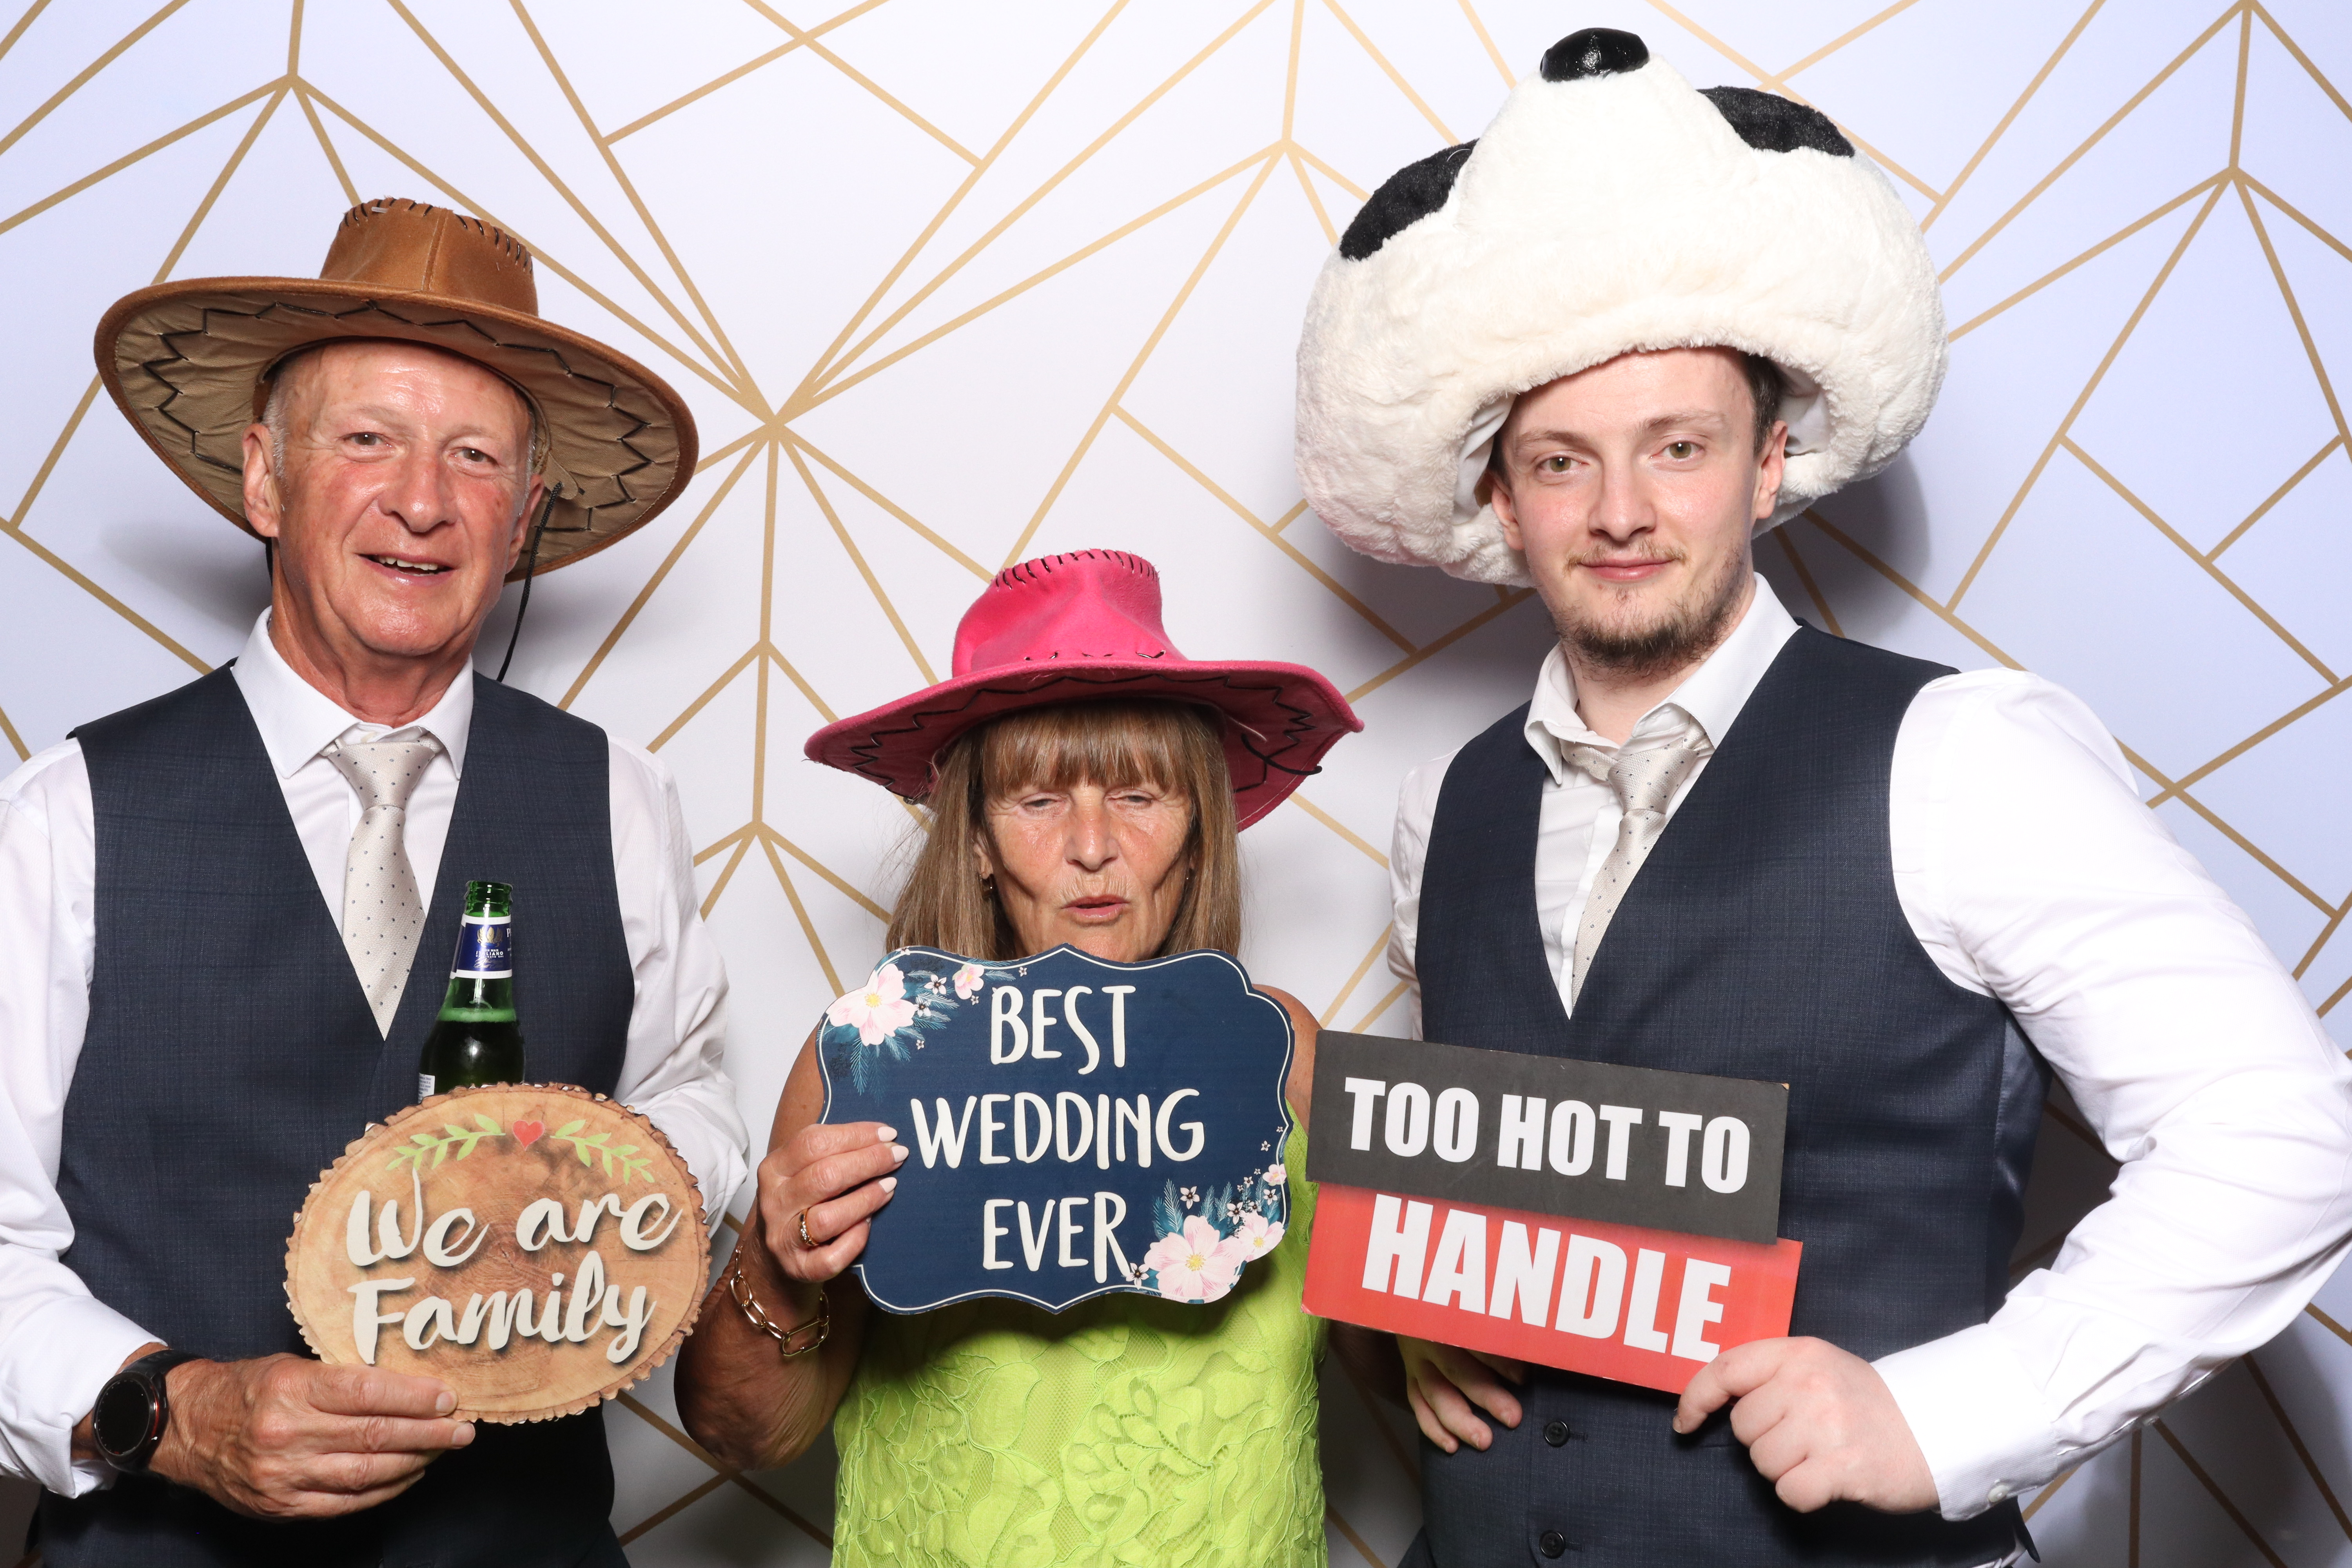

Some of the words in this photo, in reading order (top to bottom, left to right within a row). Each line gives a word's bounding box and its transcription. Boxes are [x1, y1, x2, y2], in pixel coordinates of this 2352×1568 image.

[990, 985, 1136, 1075] BEST
[910, 1088, 1205, 1170] WEDDING
[1345, 1076, 1480, 1163] TOO
[1497, 1094, 1643, 1181] HOT
[1658, 1110, 1751, 1194] TO
[347, 1167, 489, 1267] We
[516, 1193, 683, 1251] are
[982, 1191, 1131, 1284] EVER
[347, 1250, 657, 1365] Family
[1361, 1193, 1732, 1363] HANDLE
